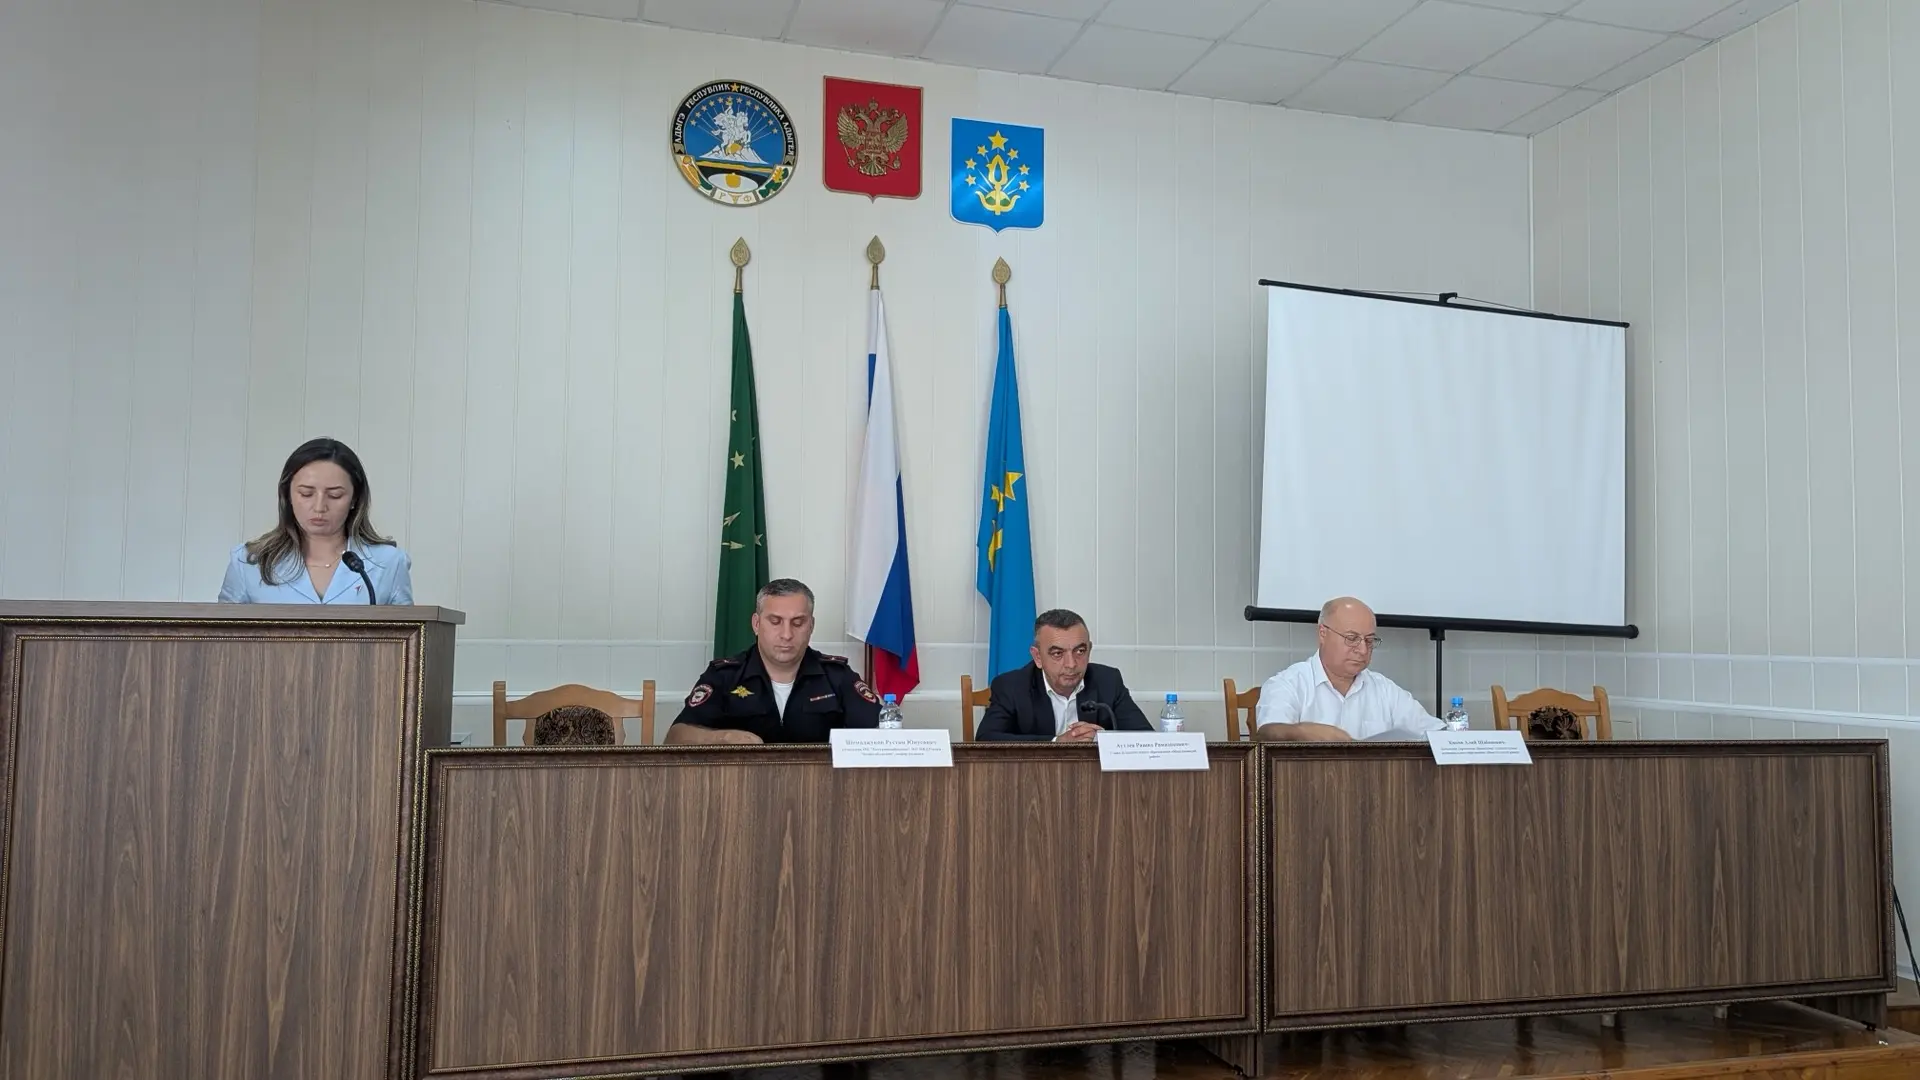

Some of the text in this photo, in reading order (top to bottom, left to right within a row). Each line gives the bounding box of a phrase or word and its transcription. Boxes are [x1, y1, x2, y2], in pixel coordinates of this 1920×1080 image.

[675, 83, 731, 144] АДЫГЭ РЕСПУБЛИК
[739, 84, 796, 156] РЕСПУБЛИКА АДЫГЕЯ
